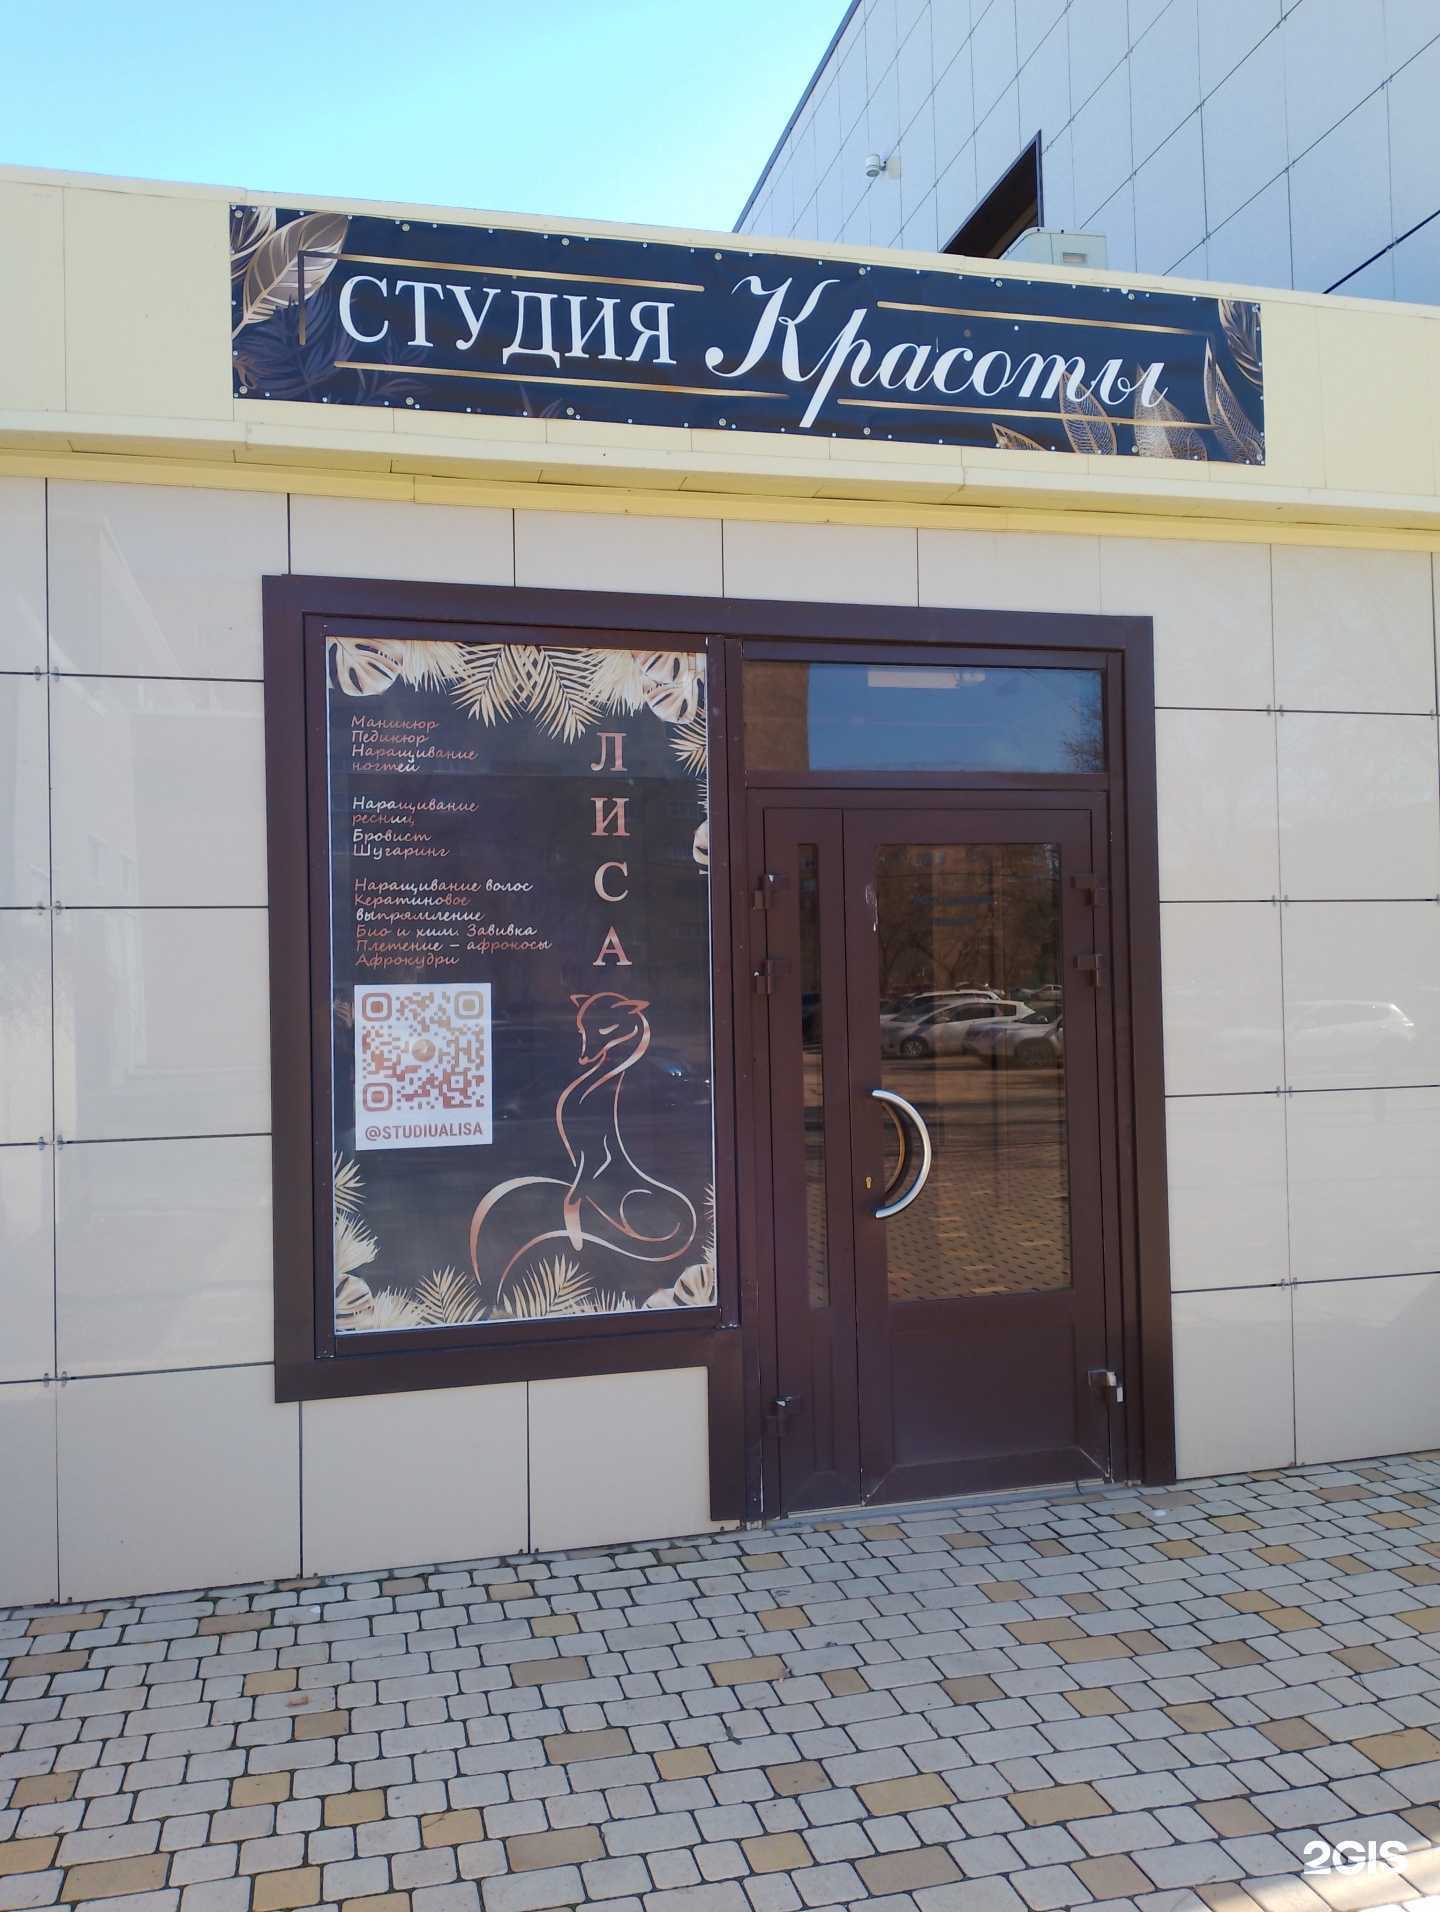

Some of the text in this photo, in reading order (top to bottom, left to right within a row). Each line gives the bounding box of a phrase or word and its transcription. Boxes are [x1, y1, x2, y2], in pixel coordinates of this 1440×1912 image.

[338, 275, 1169, 428] СТУДИЯ Красоты
[351, 714, 439, 734] Маникюр
[351, 730, 429, 747] Педикюр
[351, 743, 479, 764] Наращивание
[352, 755, 420, 773] ногтей
[352, 795, 480, 814] Наращивание
[352, 813, 417, 827] ресниц
[352, 828, 432, 844] Бровист
[352, 843, 450, 860] Шугаринг
[590, 731, 633, 967] ЛИСА
[354, 877, 534, 896] Наращивание волос
[354, 893, 471, 909] Кератиновое
[356, 907, 485, 924] выпрямление
[356, 924, 391, 938] Био
[396, 928, 410, 937] и
[466, 923, 537, 938] Завивка
[356, 938, 443, 953] Плетение
[466, 937, 553, 955] афрокосы
[354, 952, 460, 969] Афрокудри
[364, 1122, 484, 1141] @STUDIUALISA
